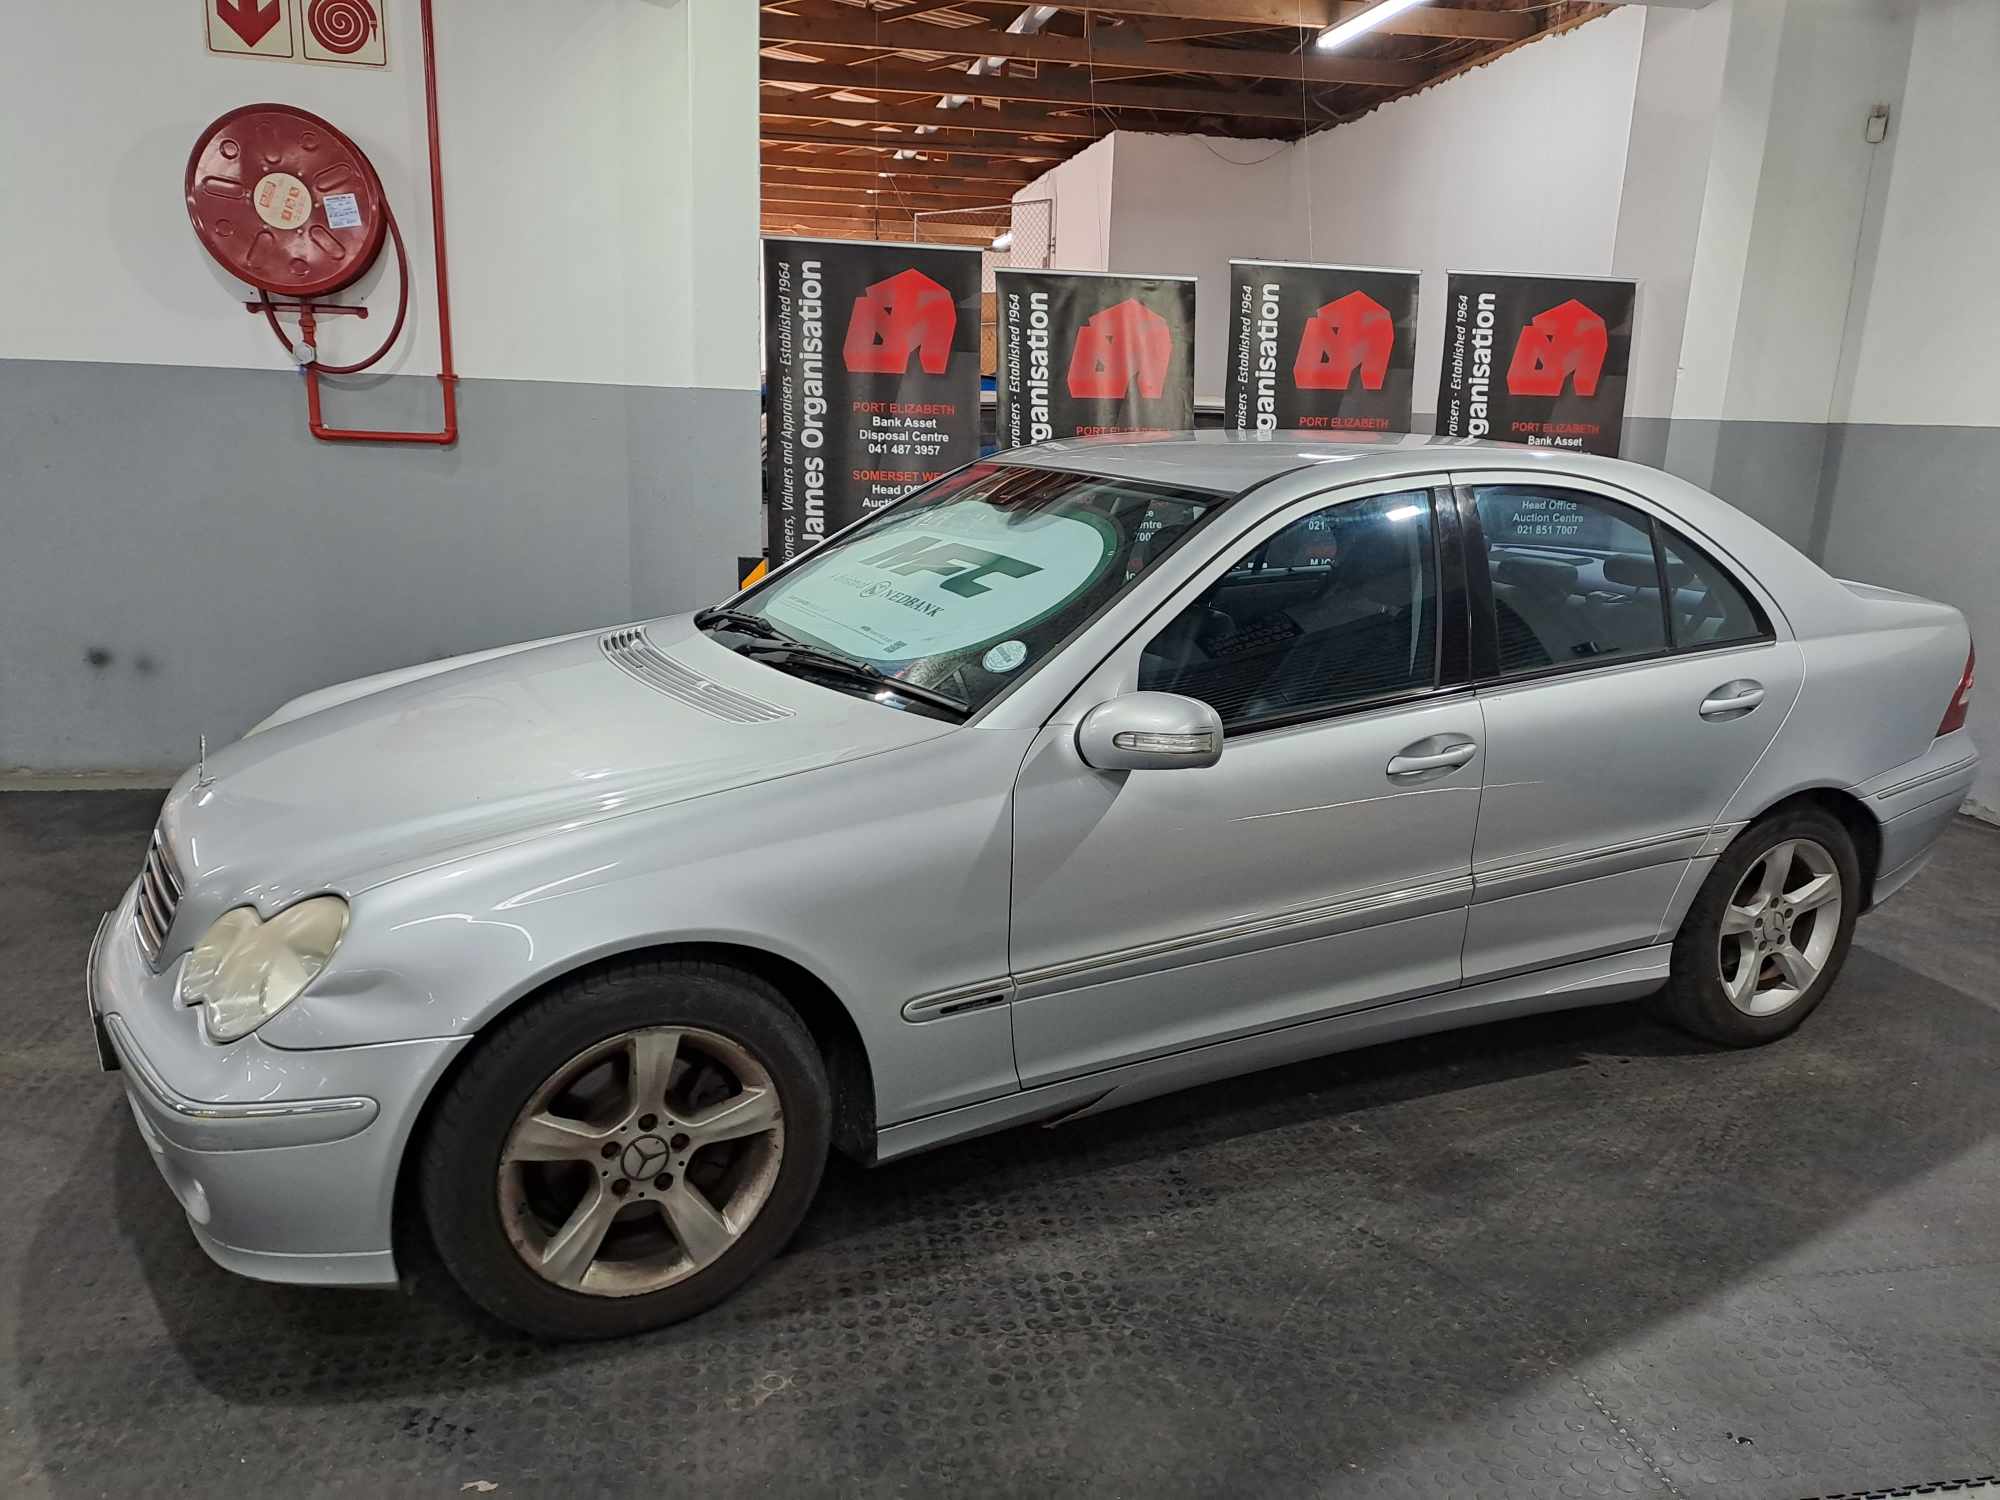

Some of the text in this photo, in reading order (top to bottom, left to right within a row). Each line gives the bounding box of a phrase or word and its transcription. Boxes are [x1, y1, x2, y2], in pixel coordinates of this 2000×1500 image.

[779, 262, 791, 293] 1964
[1008, 293, 1020, 323] 1964
[1240, 285, 1253, 314] 1964
[1456, 294, 1469, 322] 1964
[779, 297, 791, 365] Established
[1008, 325, 1021, 392] Established
[1237, 317, 1251, 383] Established
[1254, 283, 1280, 430] ganisation
[1450, 325, 1466, 390] Established
[1027, 292, 1053, 443] ganisation
[1467, 293, 1496, 437] ganisation
[780, 376, 795, 438] Appraisers
[798, 260, 827, 545] James Organisation
[853, 402, 955, 416] PORT ELIZABETH
[1236, 393, 1248, 430] raisers
[872, 416, 936, 428] Bank Asset
[1009, 402, 1021, 448] praisers
[1076, 426, 1106, 435] PORT
[1299, 416, 1389, 429] PORT ELIZABETH
[1447, 399, 1460, 436] raisers
[1512, 422, 1600, 434] PORT ELIZABETH
[859, 429, 949, 443] Disposal Centre
[868, 443, 940, 456] 041 487 3957
[1528, 435, 1582, 447] Bank Asset
[781, 442, 793, 465] and
[781, 468, 794, 511] Valuers
[853, 470, 943, 480] SOMERSET WE
[872, 484, 900, 495] Head
[1513, 513, 1584, 523] Auction Centre
[1522, 500, 1577, 510] Head Office
[783, 516, 796, 562] ioneers,
[1308, 520, 1326, 531] 021
[1517, 525, 1578, 535] 021 851 7007
[881, 588, 944, 617] NEDBANK
